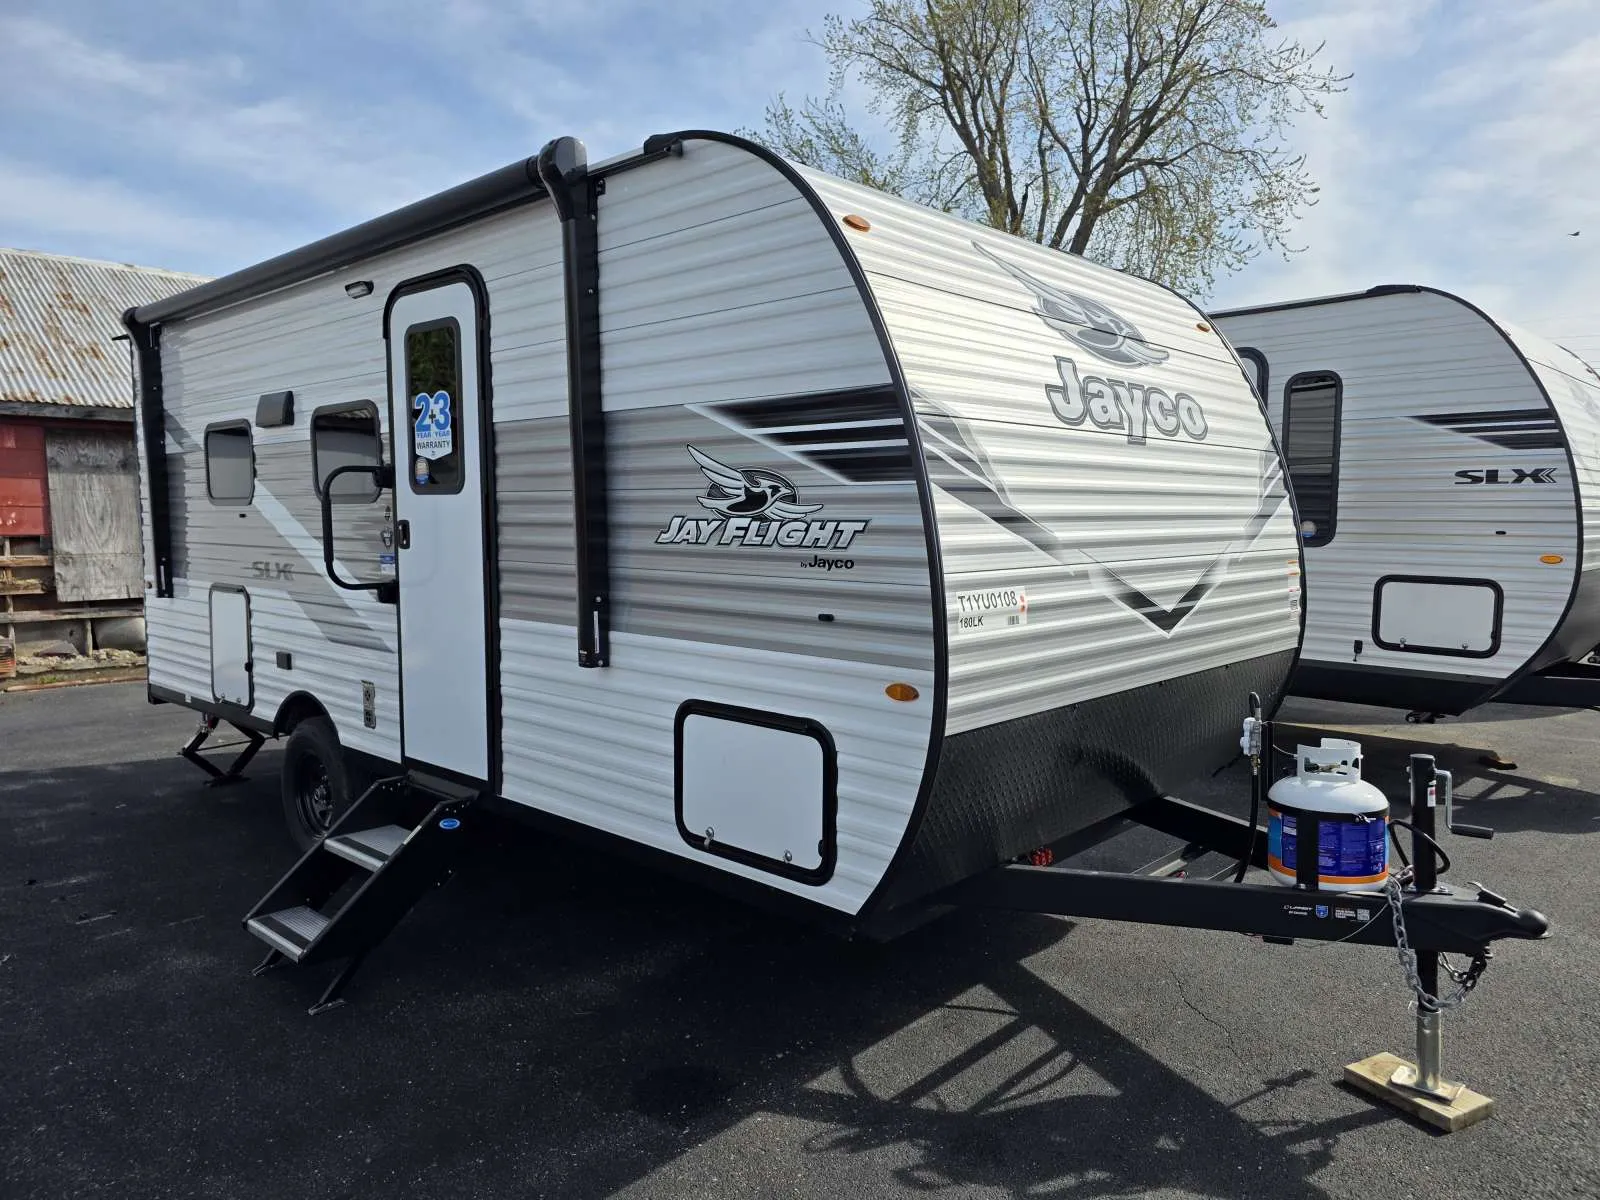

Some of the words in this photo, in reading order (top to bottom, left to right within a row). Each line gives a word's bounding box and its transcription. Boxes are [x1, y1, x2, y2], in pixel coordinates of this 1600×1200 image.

[1045, 355, 1208, 446] Jayco
[417, 440, 450, 449] WARRANTY
[1454, 468, 1557, 484] SLX
[655, 516, 725, 546] JAY
[716, 517, 873, 549] FLIGHT
[809, 555, 854, 571] Jayco
[957, 590, 1018, 612] T1YU0108
[959, 616, 984, 628] 180LK
